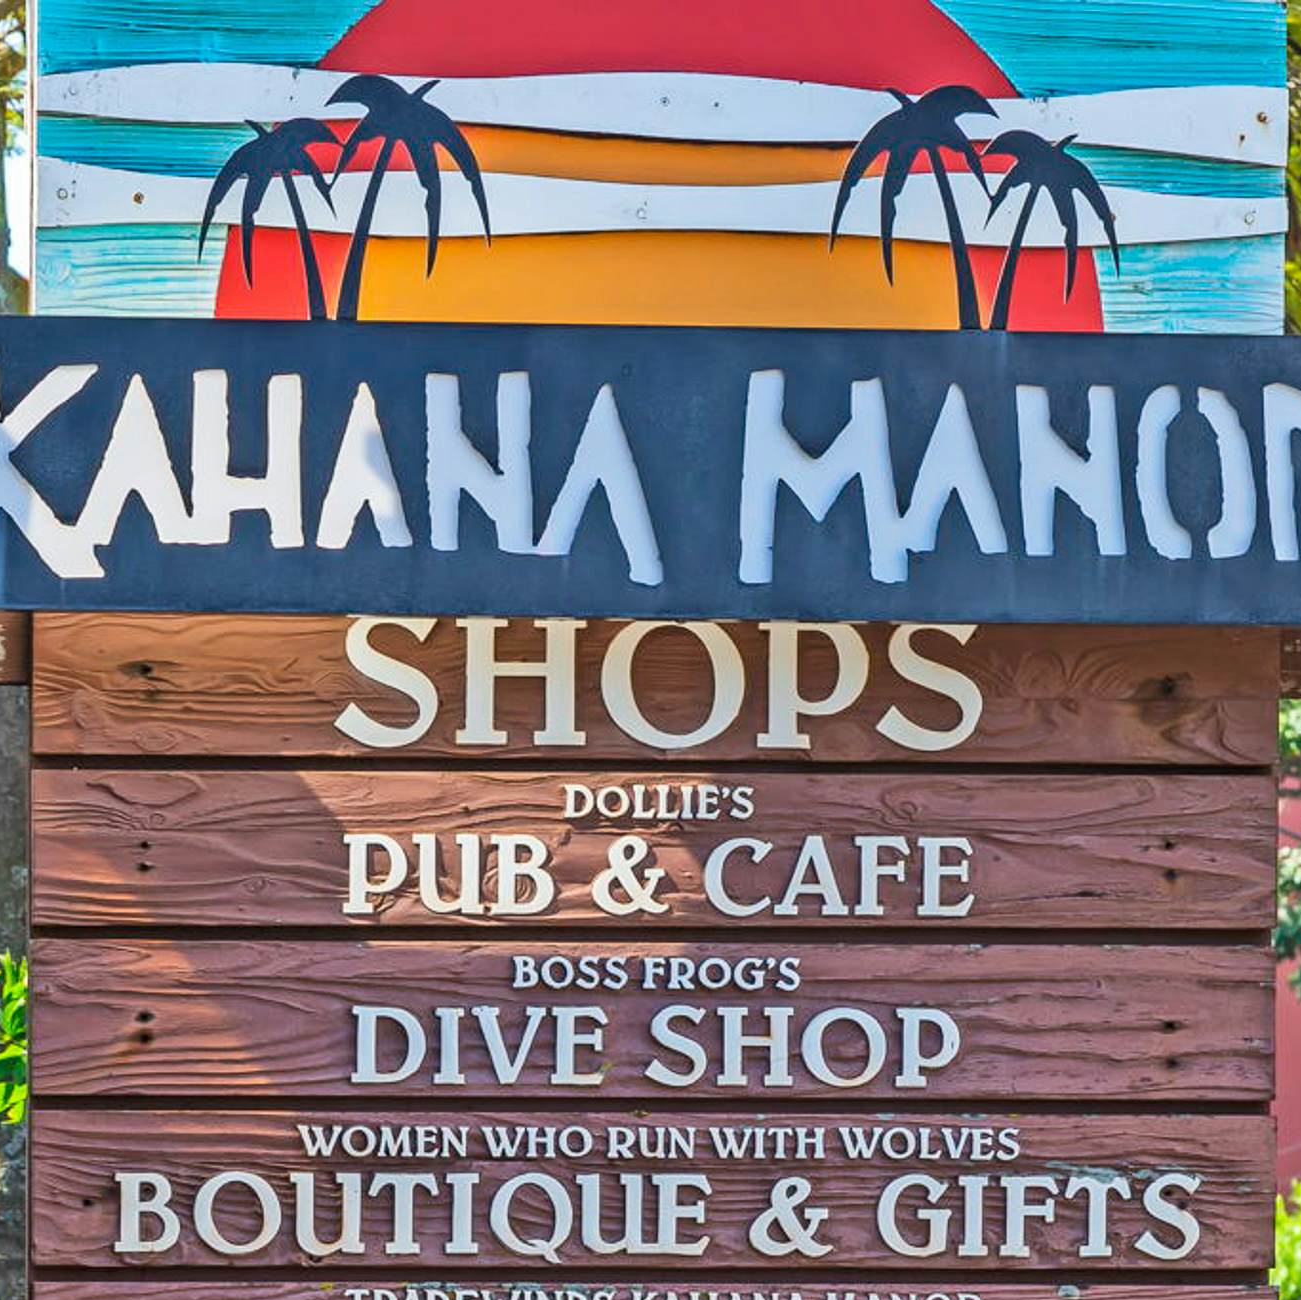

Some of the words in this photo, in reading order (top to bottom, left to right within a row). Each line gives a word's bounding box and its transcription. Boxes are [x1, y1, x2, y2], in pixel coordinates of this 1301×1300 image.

[333, 615, 984, 752] SHOPS
[563, 783, 755, 821] DOLLIE'S
[342, 833, 555, 916] PUB
[591, 836, 670, 915] &
[703, 834, 976, 917] CAFE
[512, 955, 629, 990] BOSS
[642, 956, 801, 992] FROG'S
[350, 1004, 609, 1085] DIVE
[643, 1004, 962, 1088] SHOP
[296, 1124, 470, 1158] WOMEN
[482, 1124, 593, 1159] WHO
[607, 1125, 696, 1160] RUN
[709, 1126, 826, 1160] WITH
[838, 1126, 1022, 1162] WOLVES
[113, 1170, 712, 1264] BOUTIQUE
[748, 1175, 834, 1258] &
[875, 1173, 1202, 1261] GIFTS
